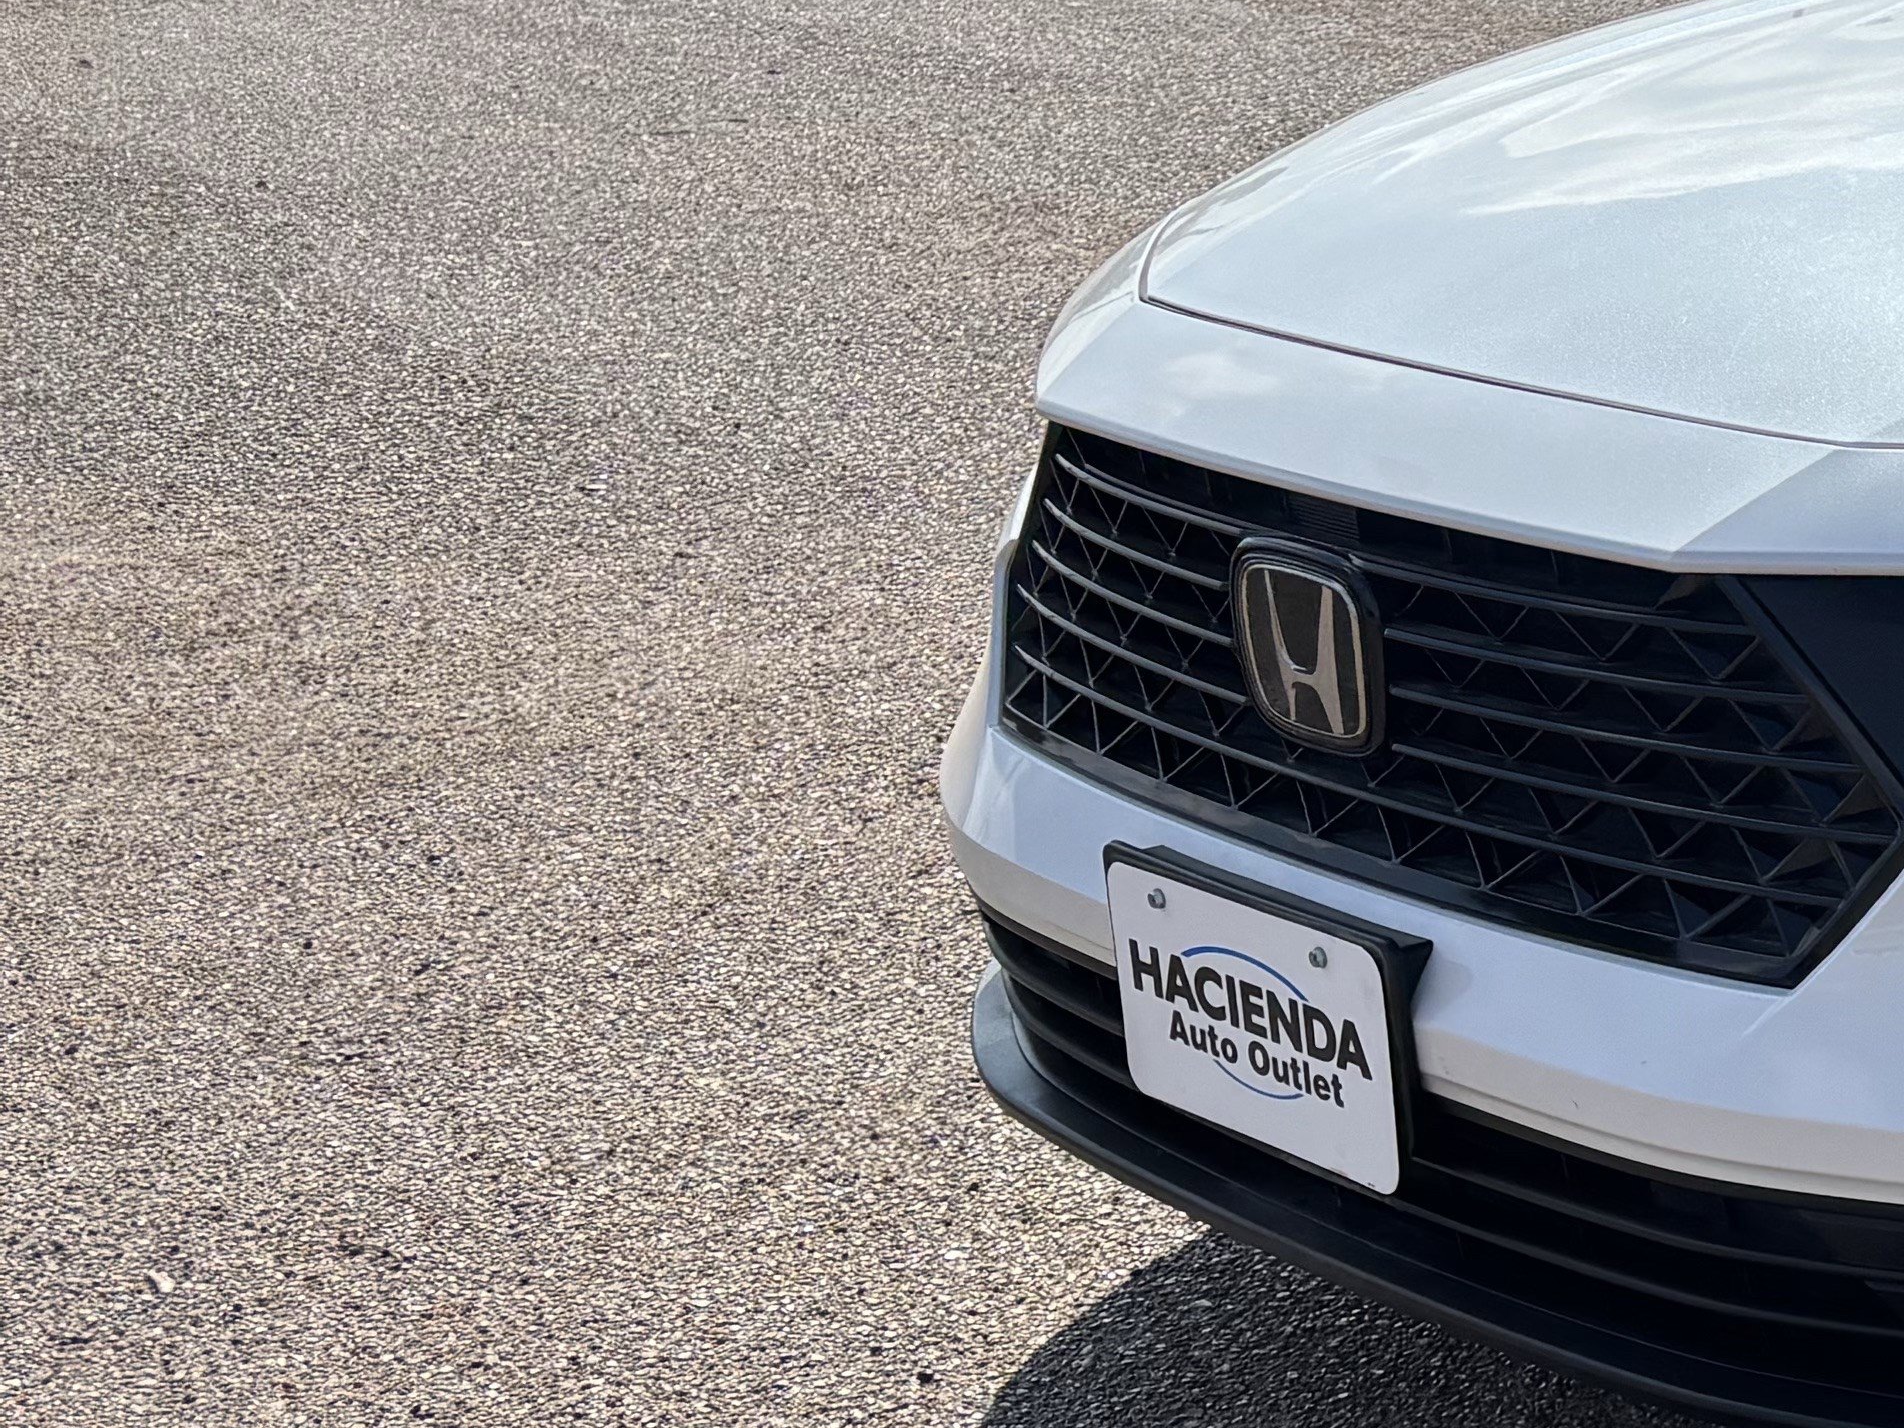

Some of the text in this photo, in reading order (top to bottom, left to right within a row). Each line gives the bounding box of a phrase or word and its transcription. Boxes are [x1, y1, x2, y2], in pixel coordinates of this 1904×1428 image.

[1128, 937, 1374, 1082] HACIENDA
[1168, 1009, 1346, 1109] Auto Outlet
